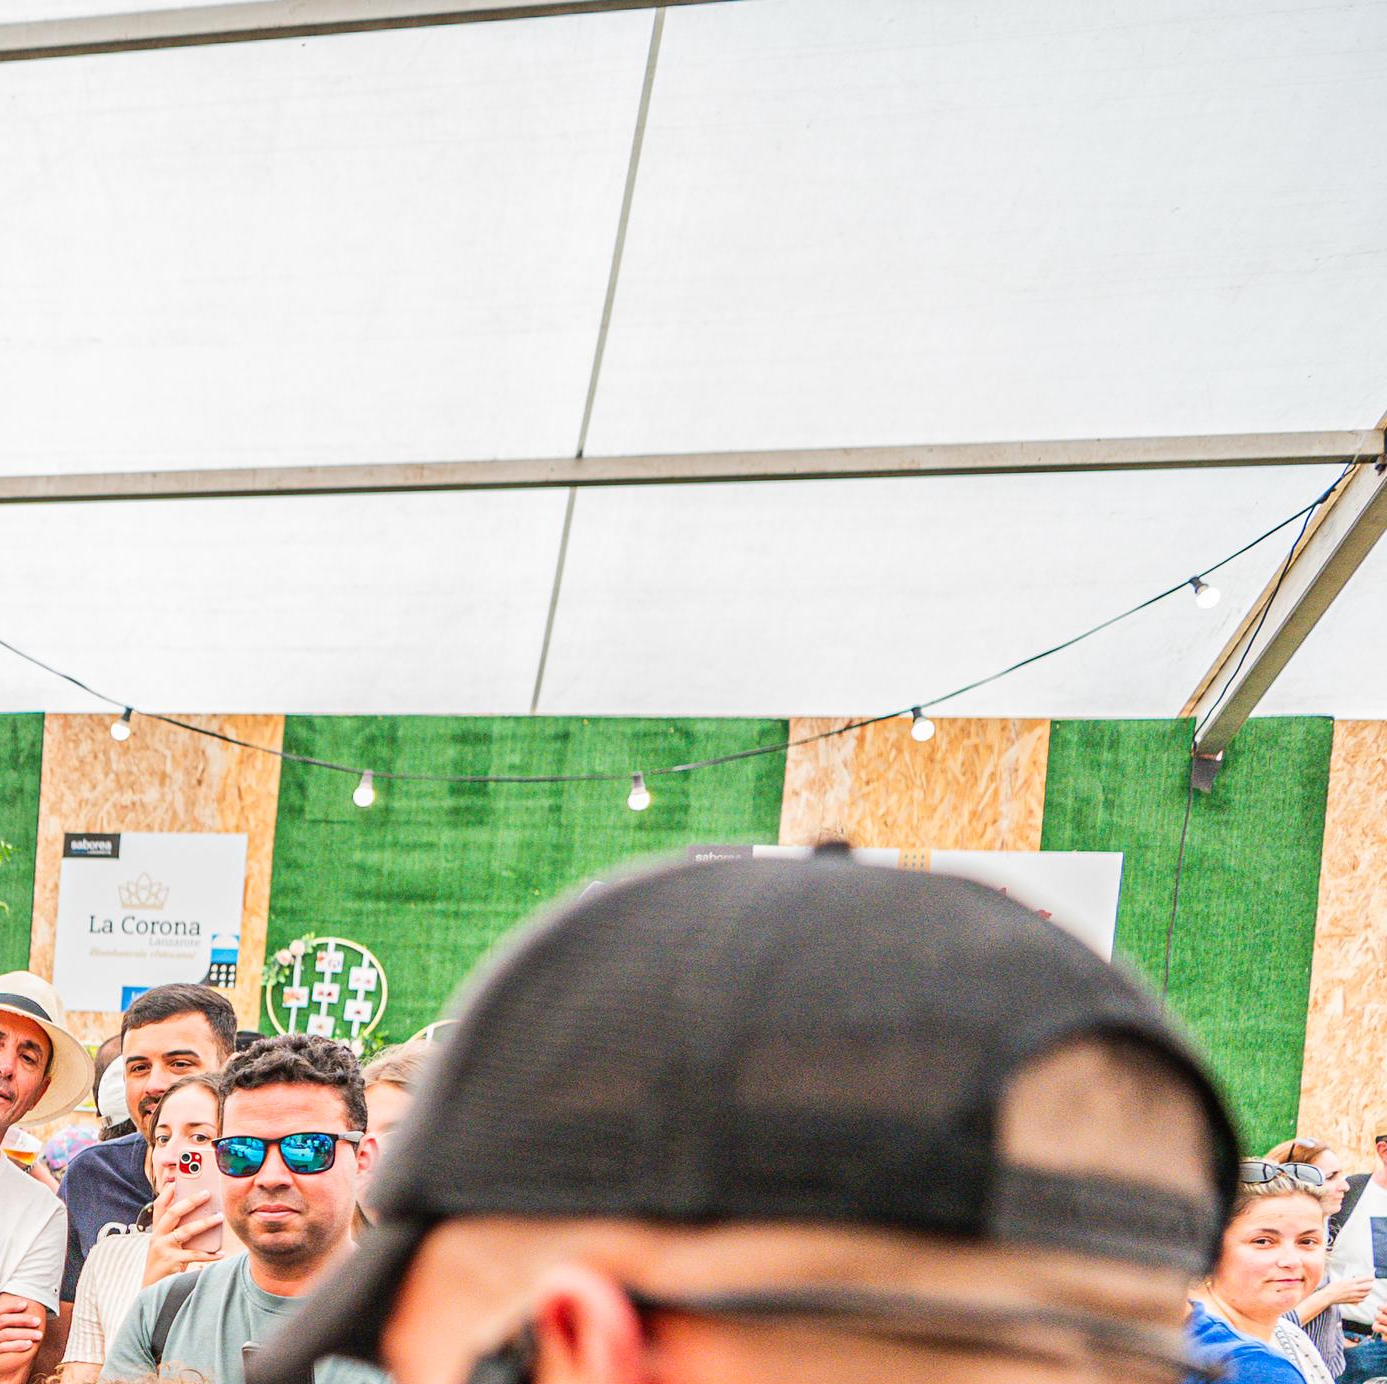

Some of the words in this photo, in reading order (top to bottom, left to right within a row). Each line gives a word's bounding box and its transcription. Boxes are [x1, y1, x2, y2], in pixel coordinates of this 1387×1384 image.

[89, 915, 113, 934] La
[121, 915, 201, 936] Corona
[148, 937, 201, 947] Lanzarote
